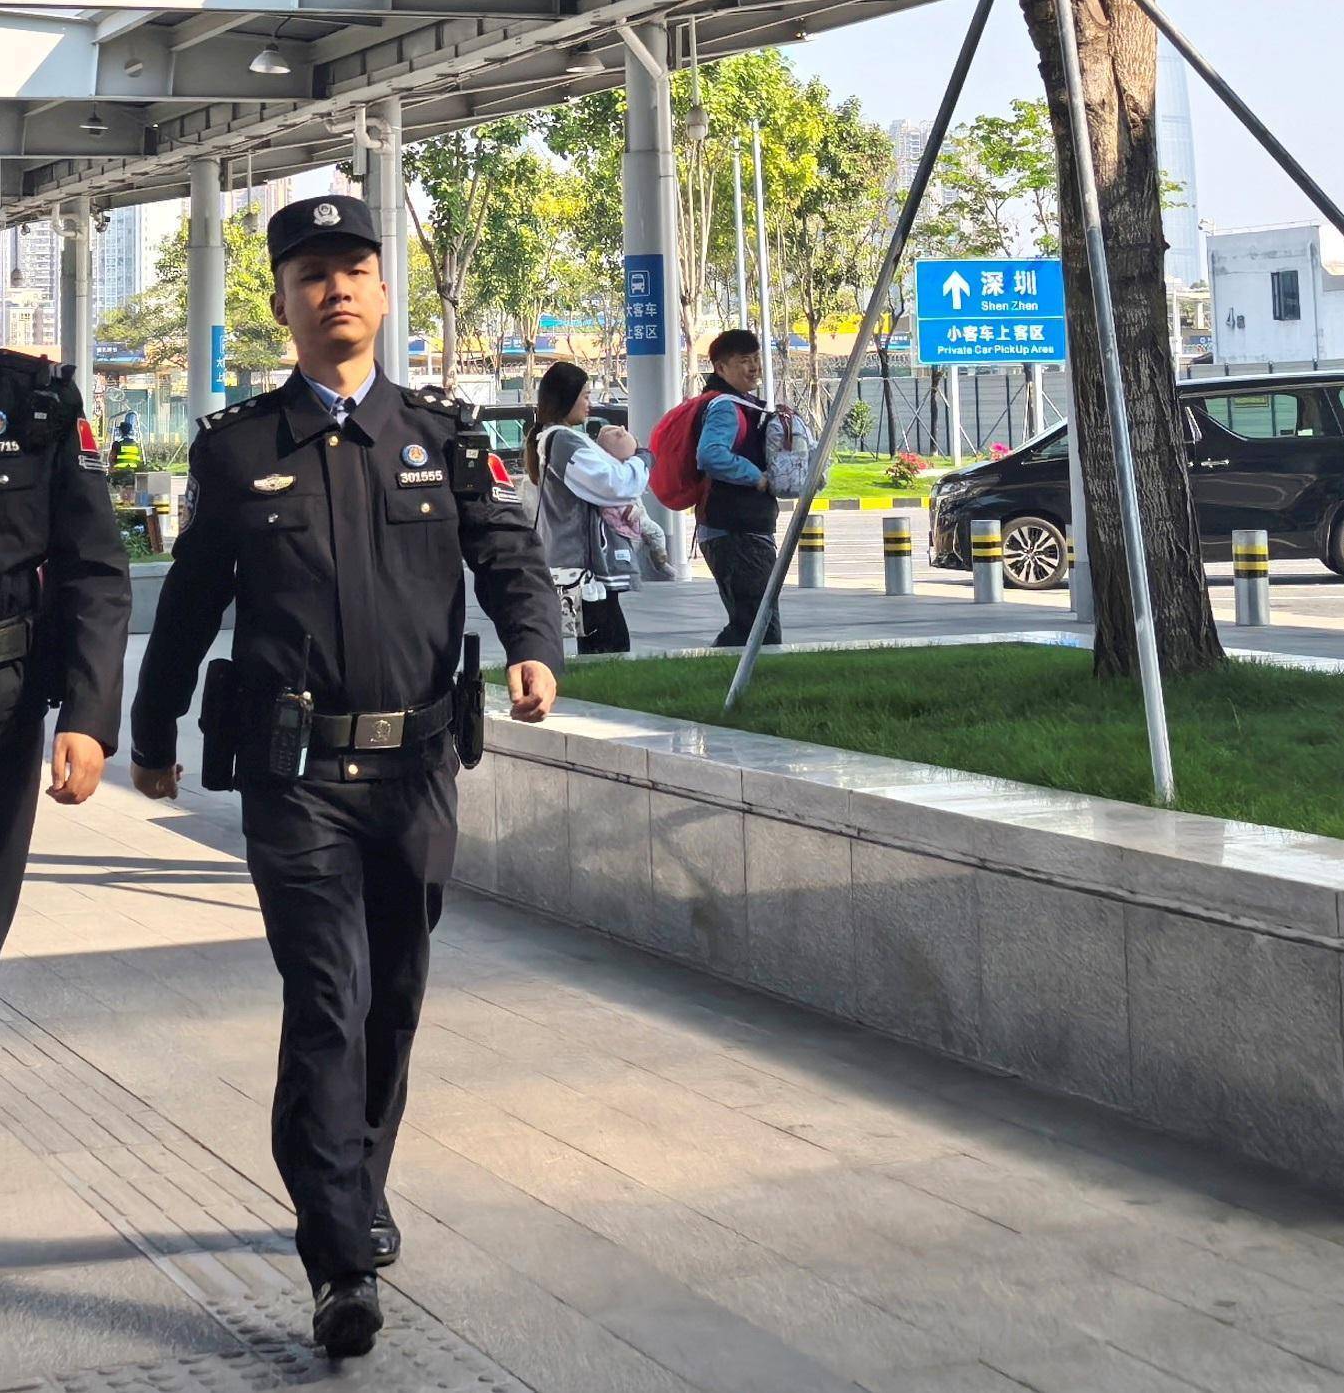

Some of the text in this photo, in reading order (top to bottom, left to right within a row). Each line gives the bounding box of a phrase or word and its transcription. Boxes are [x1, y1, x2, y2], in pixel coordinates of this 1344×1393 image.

[980, 269, 1038, 296] 深圳
[981, 301, 1039, 312] Shen Zhen
[946, 324, 1046, 343] 小客车上客区
[937, 345, 973, 355] Private
[974, 345, 993, 355] Car
[1031, 345, 1054, 355] Area
[400, 470, 443, 483] 301555
